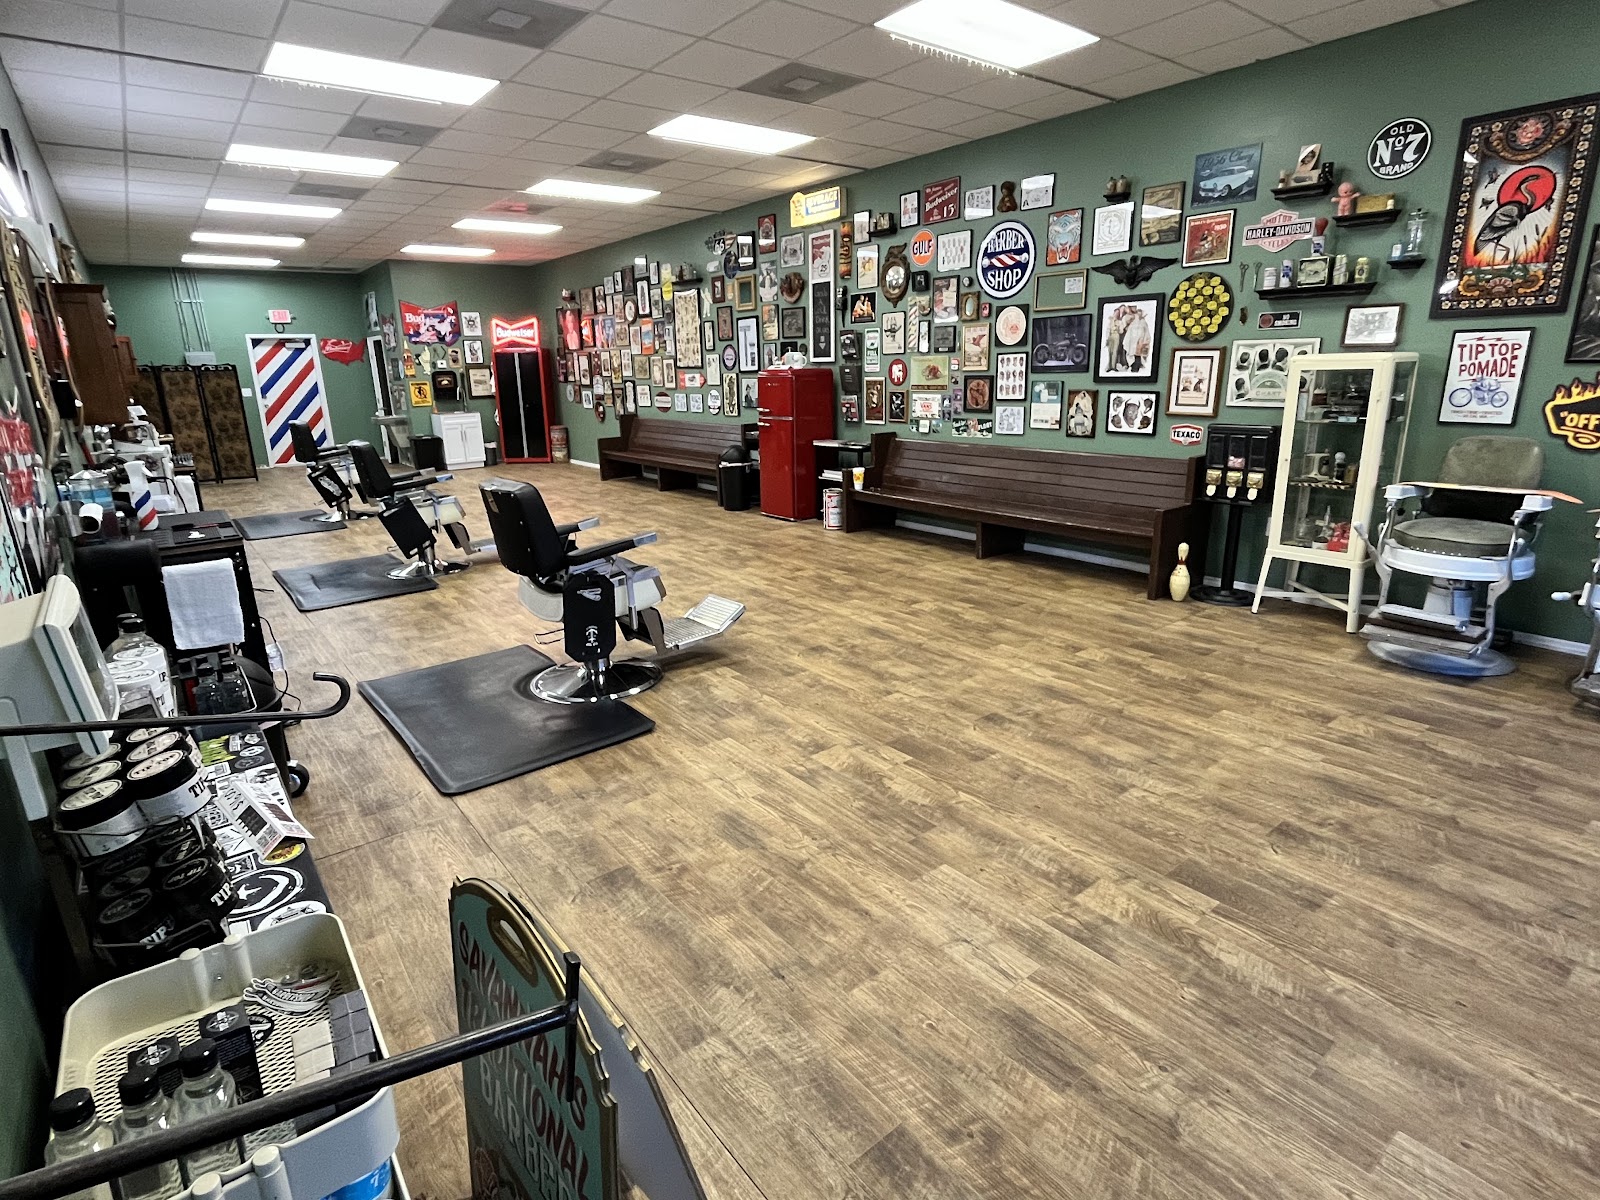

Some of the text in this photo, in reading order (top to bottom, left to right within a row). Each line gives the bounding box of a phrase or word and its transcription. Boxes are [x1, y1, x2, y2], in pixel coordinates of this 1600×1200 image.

[1390, 124, 1414, 135] OLD
[1380, 162, 1413, 175] BRAND
[925, 187, 958, 212] Budweiser
[1265, 213, 1293, 225] MOTOR
[1246, 223, 1311, 240] HARLEY-DAVIDSON
[714, 238, 725, 252] 66
[913, 240, 933, 256] GULF
[987, 229, 1025, 253] BARBER
[1264, 238, 1291, 248] CYCLES
[988, 268, 1021, 290] SHOP
[496, 327, 534, 338] Budweiser
[1457, 343, 1522, 362] TIP TOP
[1458, 355, 1518, 378] POMADE
[1173, 430, 1200, 439] TEXACO
[135, 765, 152, 775] TIP
[210, 882, 232, 907] TIP
[139, 925, 167, 949] TIP
